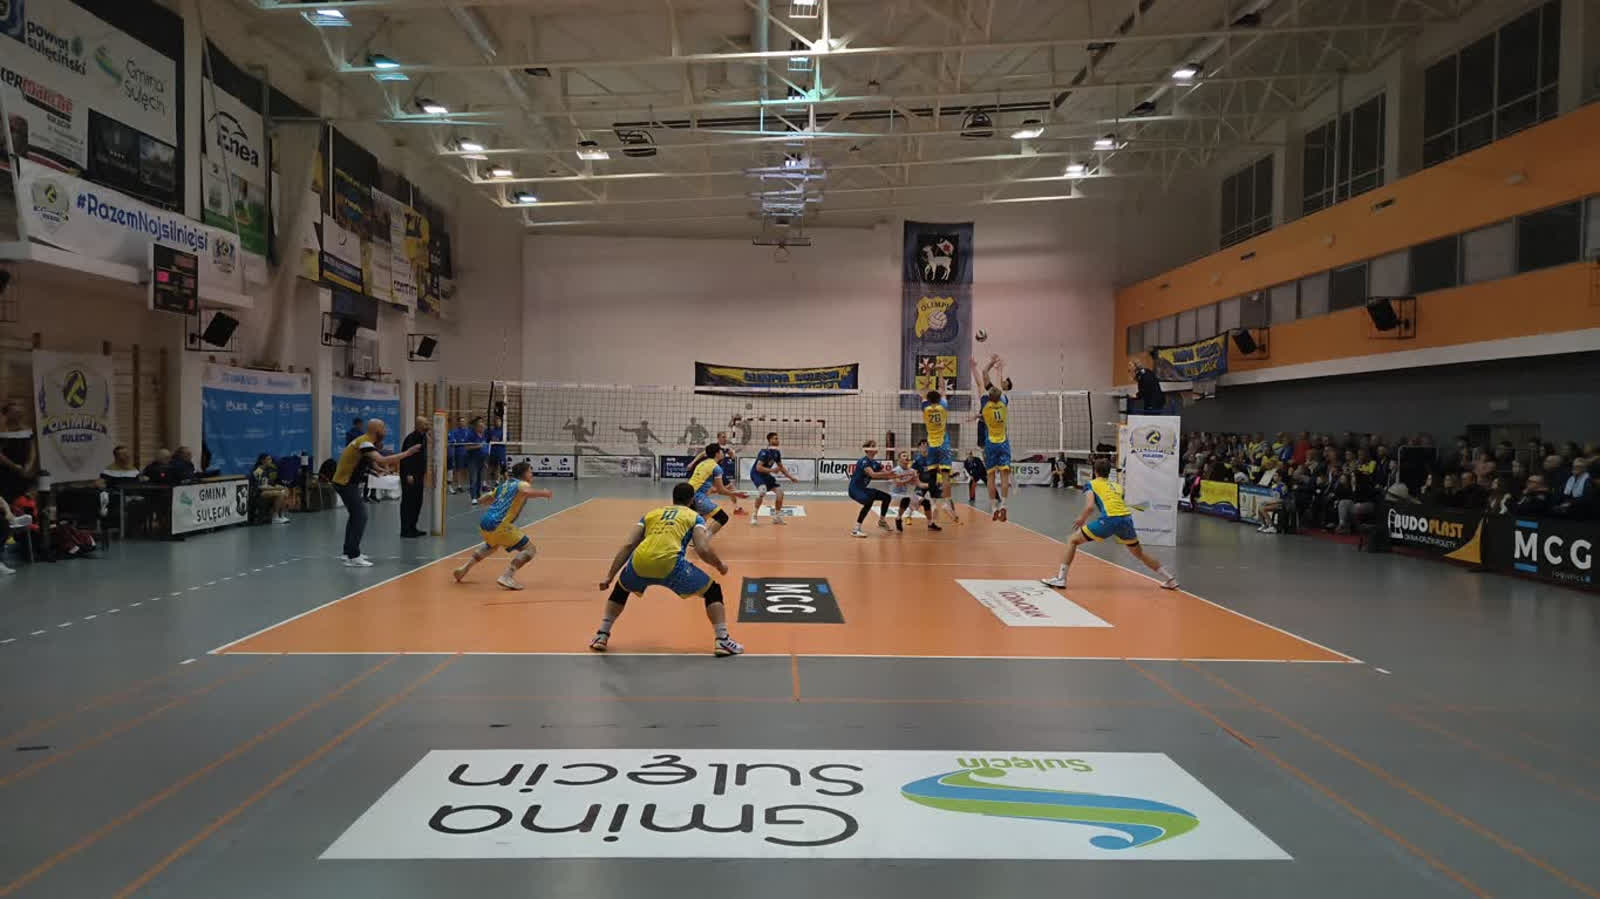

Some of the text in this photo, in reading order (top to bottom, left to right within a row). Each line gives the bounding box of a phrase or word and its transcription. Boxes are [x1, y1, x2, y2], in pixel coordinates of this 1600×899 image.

[126, 57, 165, 94] Gmina
[1014, 465, 1040, 475] ress
[199, 486, 227, 501] GMINA
[765, 583, 817, 614] MCG
[447, 754, 865, 796] Sulęcin
[956, 756, 1094, 772] Sulęcin
[427, 803, 859, 847] Gmina
